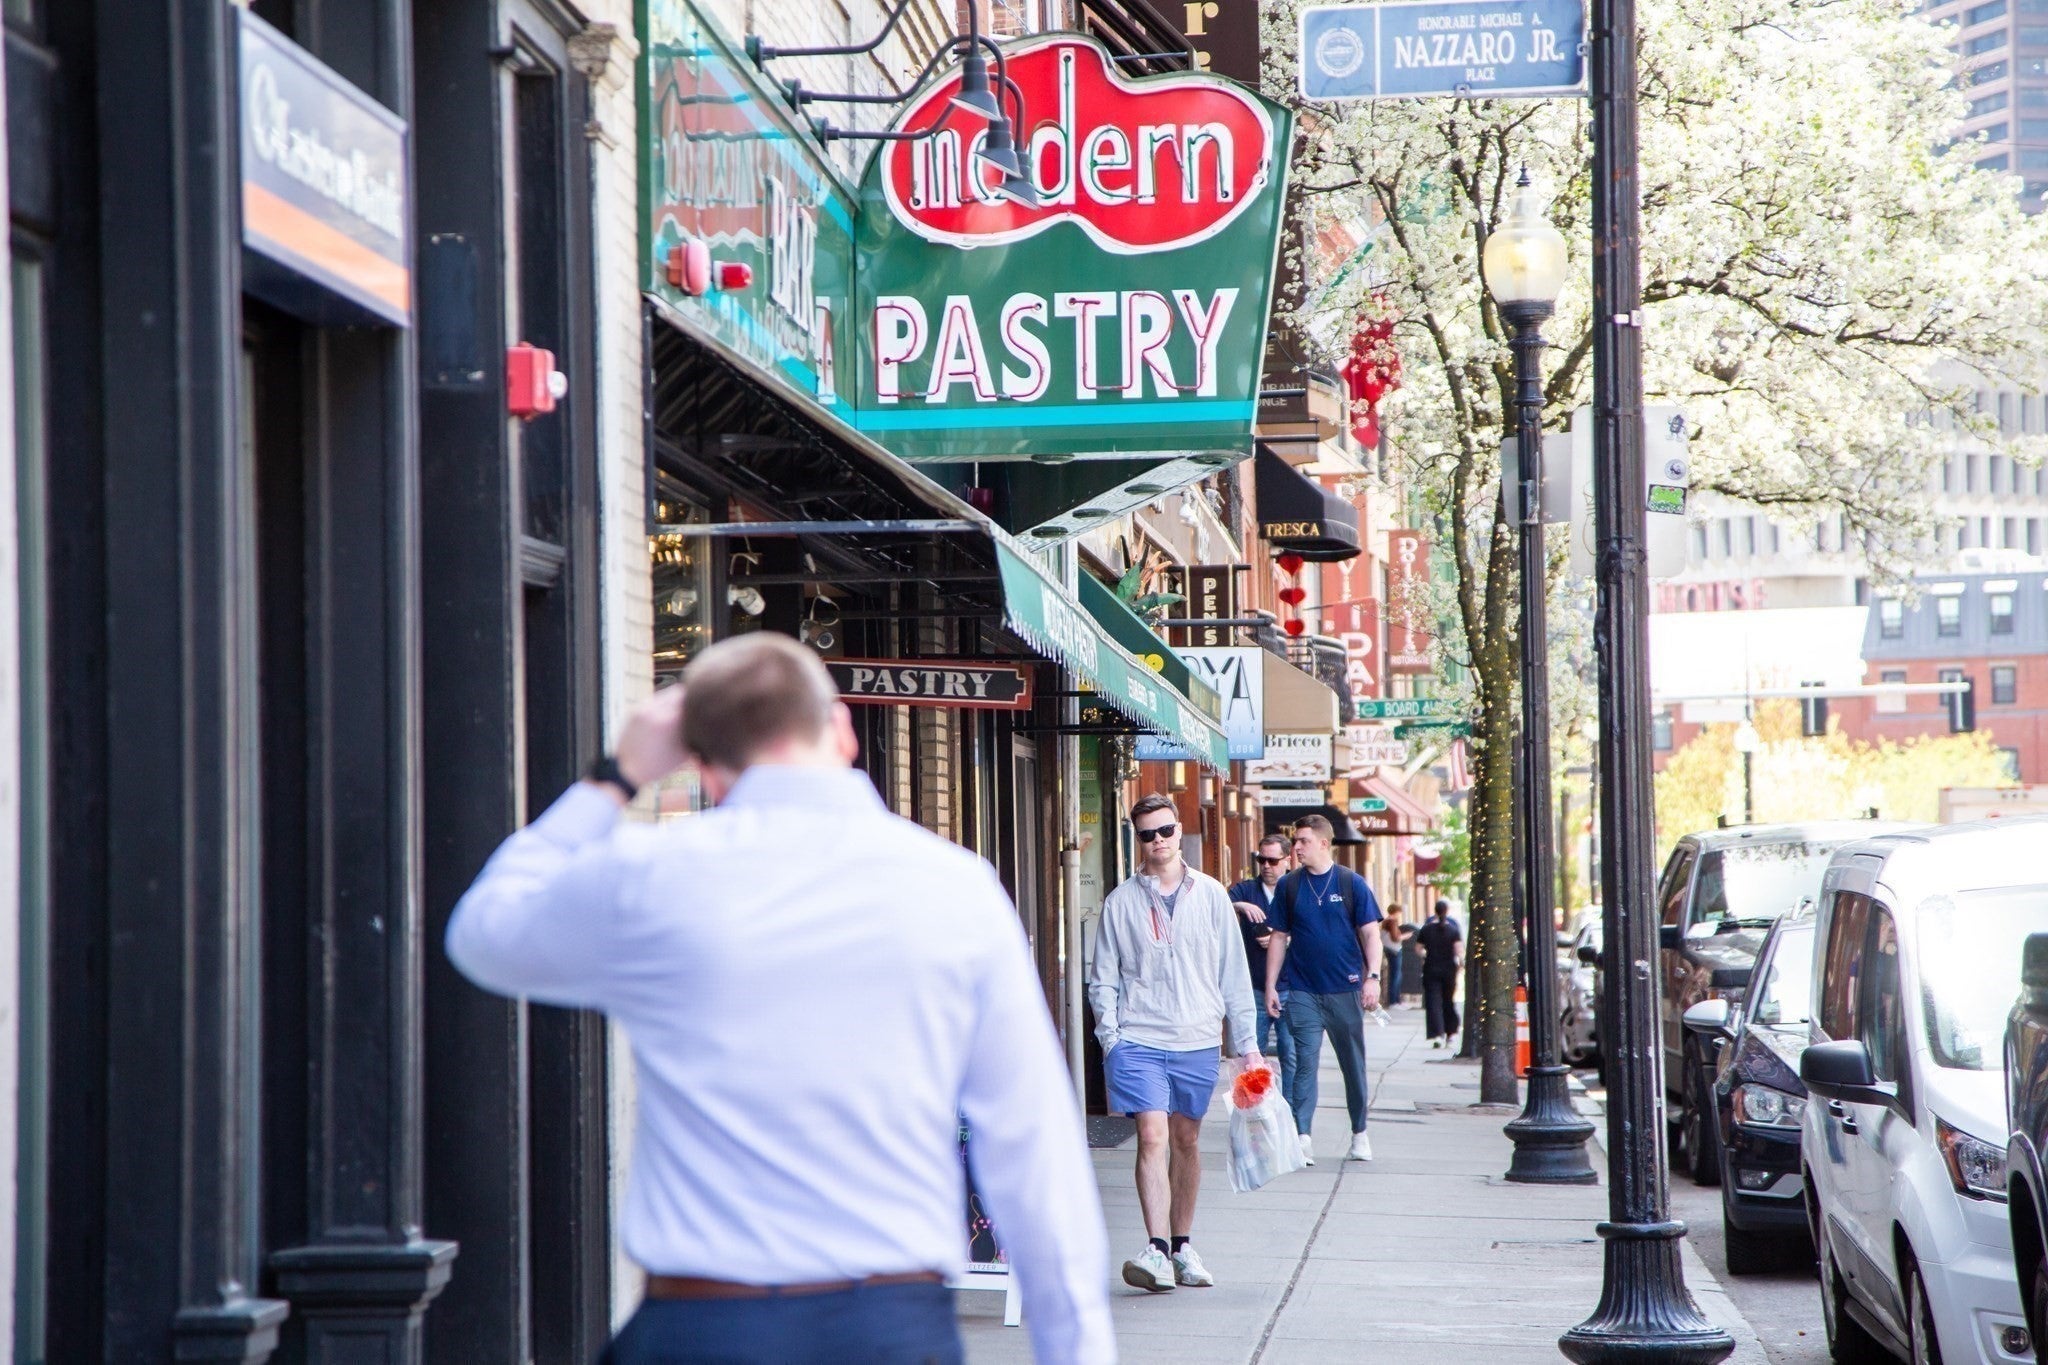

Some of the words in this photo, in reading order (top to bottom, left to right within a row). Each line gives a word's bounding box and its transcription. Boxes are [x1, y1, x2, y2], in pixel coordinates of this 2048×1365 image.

[1418, 14, 1476, 30] HONORABLE
[1480, 12, 1523, 28] MICHAEL
[1531, 12, 1543, 25] A.
[1394, 30, 1515, 68] NAZZARO
[1526, 29, 1565, 63] JR.
[1466, 67, 1495, 81] PLACE
[910, 47, 1234, 210] modern
[875, 287, 1240, 404] PASTRY
[1264, 522, 1320, 537] TRESCA
[851, 667, 993, 697] PASTRY
[1384, 701, 1419, 716] BOARD
[1264, 734, 1321, 748] Bricco
[1230, 745, 1254, 754] LOOR
[1362, 815, 1388, 829] Vita
